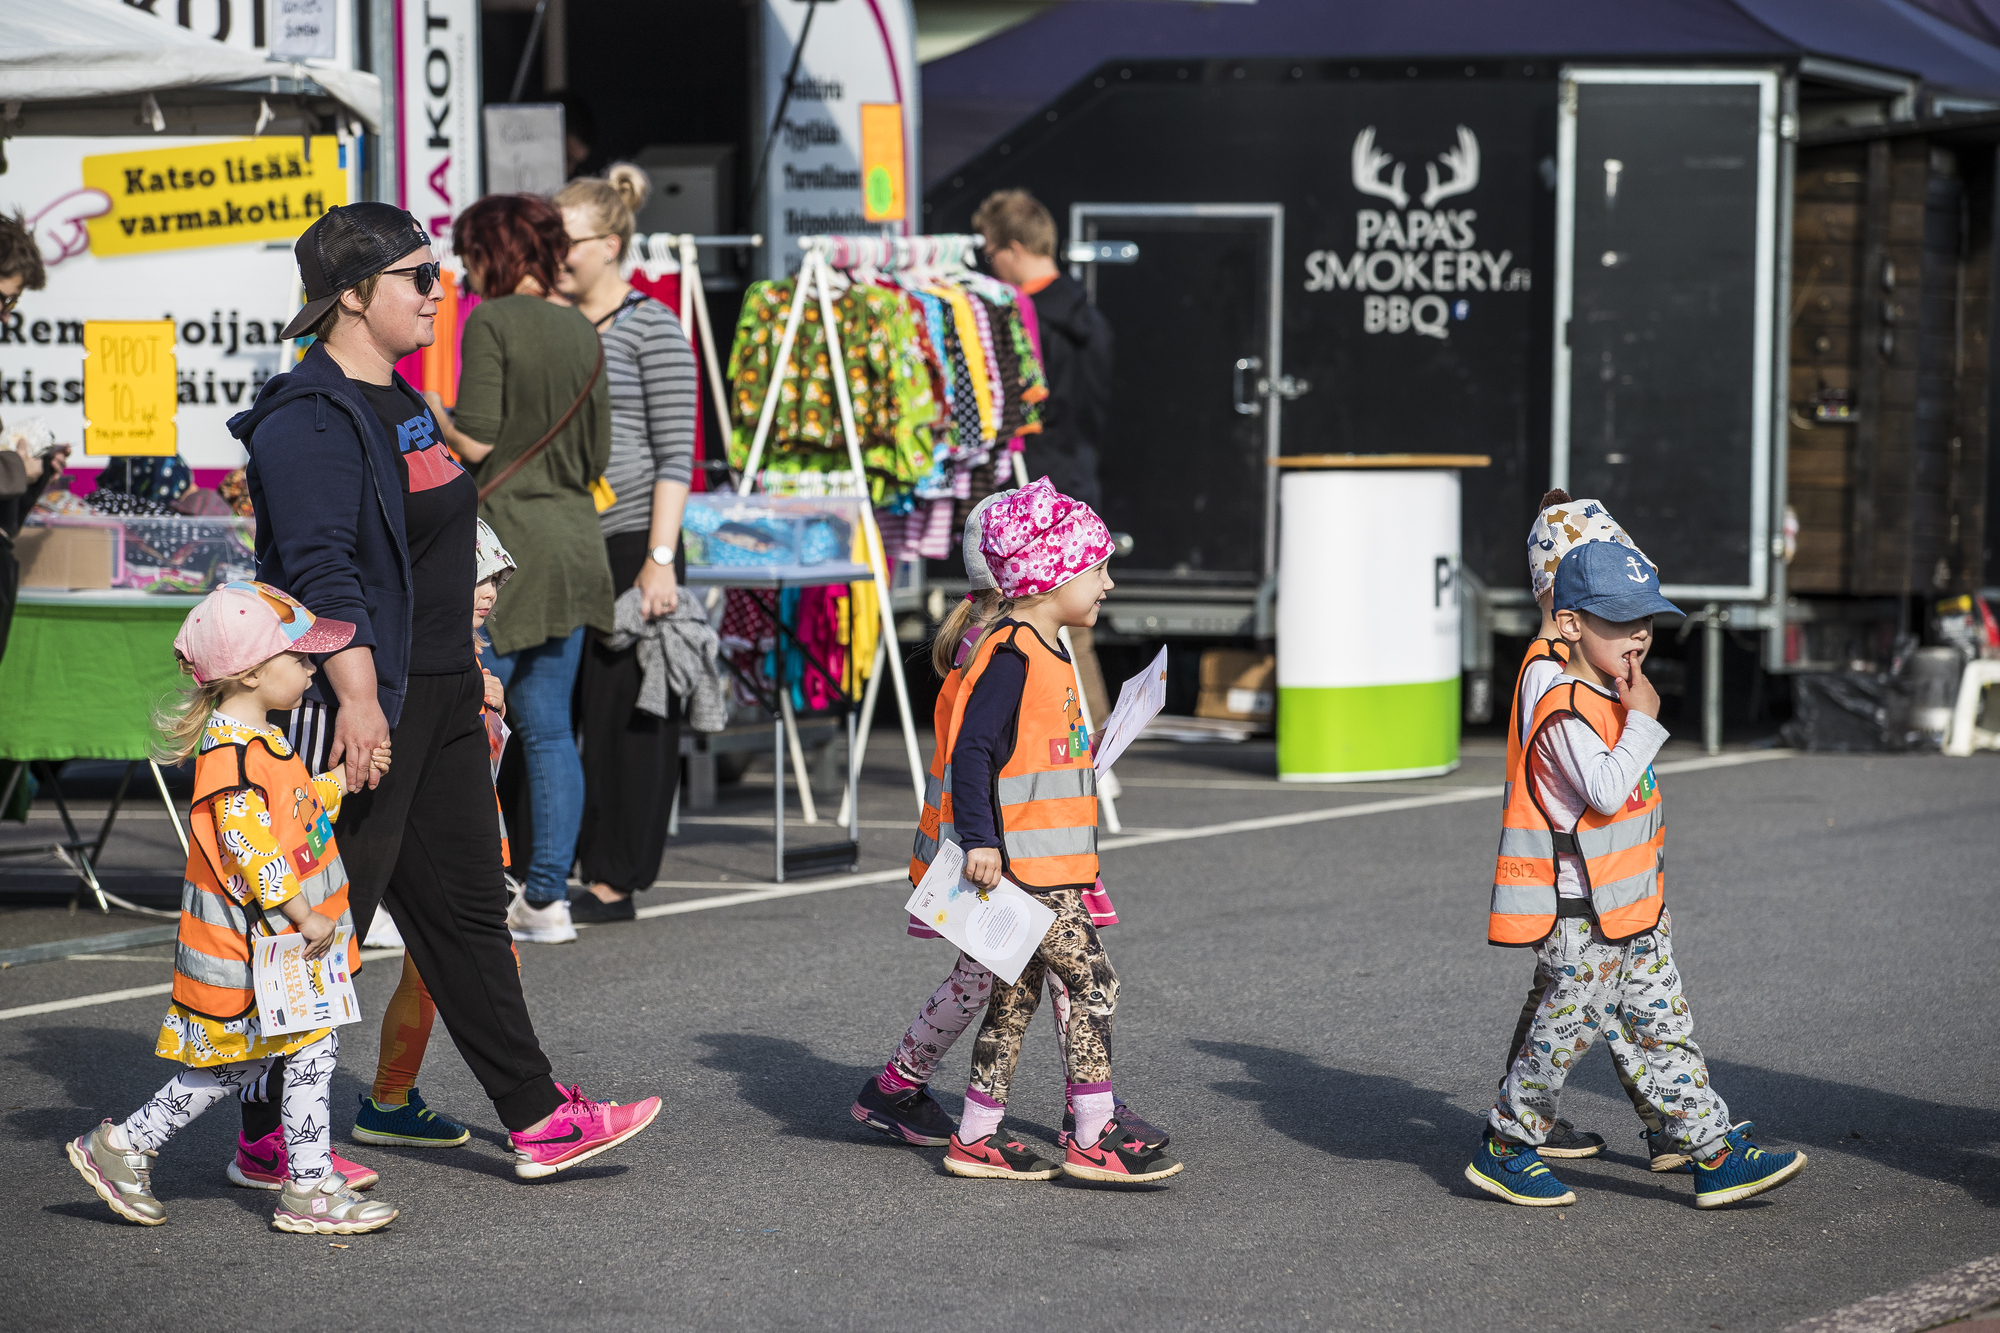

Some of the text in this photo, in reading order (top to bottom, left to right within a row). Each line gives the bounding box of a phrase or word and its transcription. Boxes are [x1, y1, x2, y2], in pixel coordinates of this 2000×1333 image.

[124, 166, 216, 195] Katso
[120, 190, 325, 236] varmakoti.fi
[1356, 208, 1478, 250] PAPA'S
[1363, 294, 1450, 340] BBQ
[100, 334, 162, 377] PIPOT
[282, 949, 299, 1016] KOKKAA
[290, 944, 308, 1019] VÄRITÄ JA
